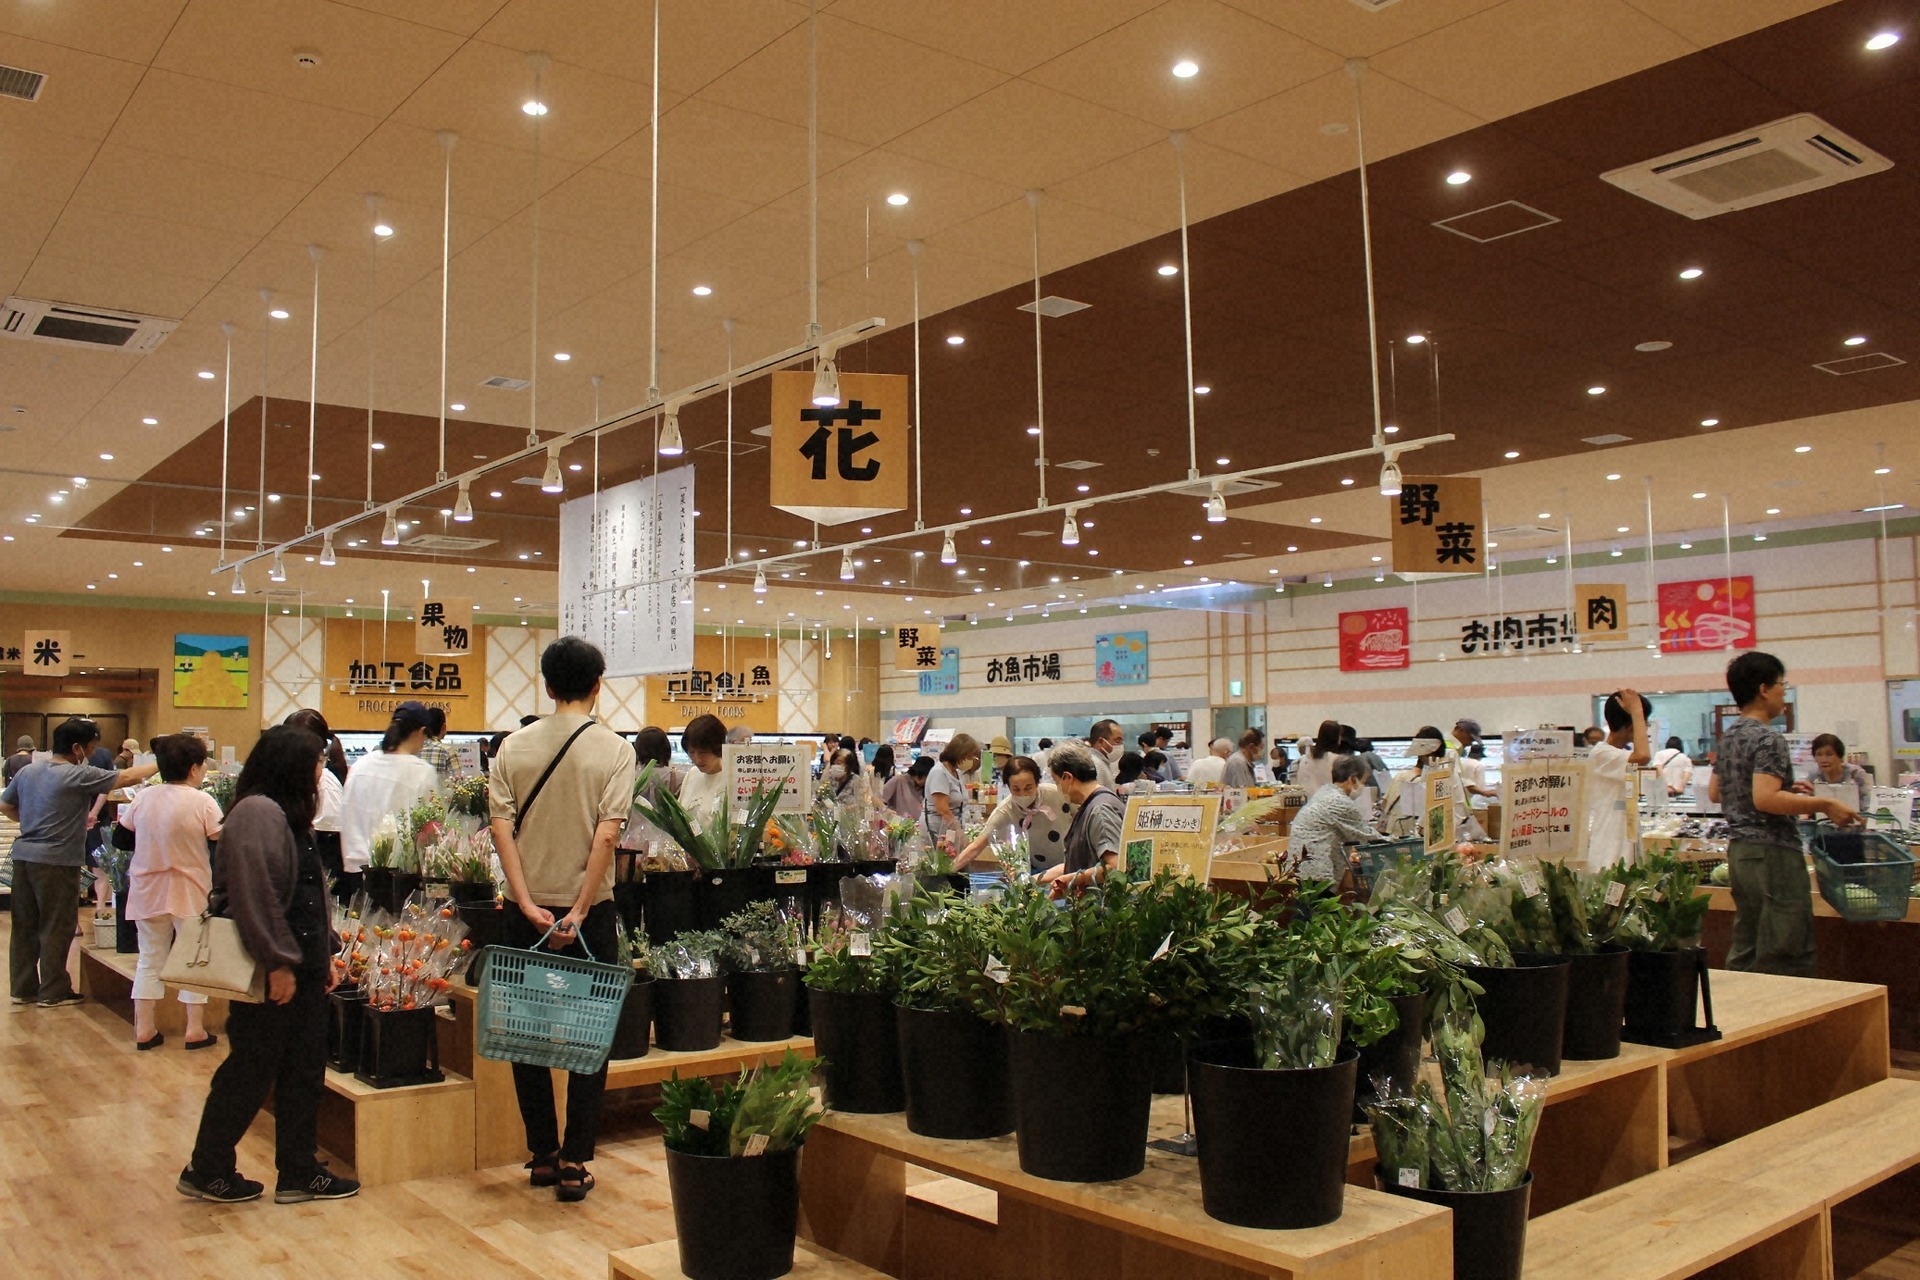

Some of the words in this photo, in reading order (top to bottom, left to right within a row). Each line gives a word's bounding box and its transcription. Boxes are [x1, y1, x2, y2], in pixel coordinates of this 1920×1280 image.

[799, 400, 881, 481] 花
[1400, 484, 1476, 564] 野菜
[421, 602, 469, 649] 果物
[1588, 596, 1618, 630] 肉
[33, 638, 62, 666] 米
[898, 628, 937, 667] 野菜
[349, 659, 463, 690] 加工食品
[752, 665, 772, 686] 魚
[987, 653, 1061, 683] お魚市場
[667, 670, 745, 697] 日配食
[358, 700, 402, 713] PROCES
[680, 705, 711, 717] DAILY
[717, 705, 745, 718] FOODS
[736, 755, 796, 764] お客様へお願い
